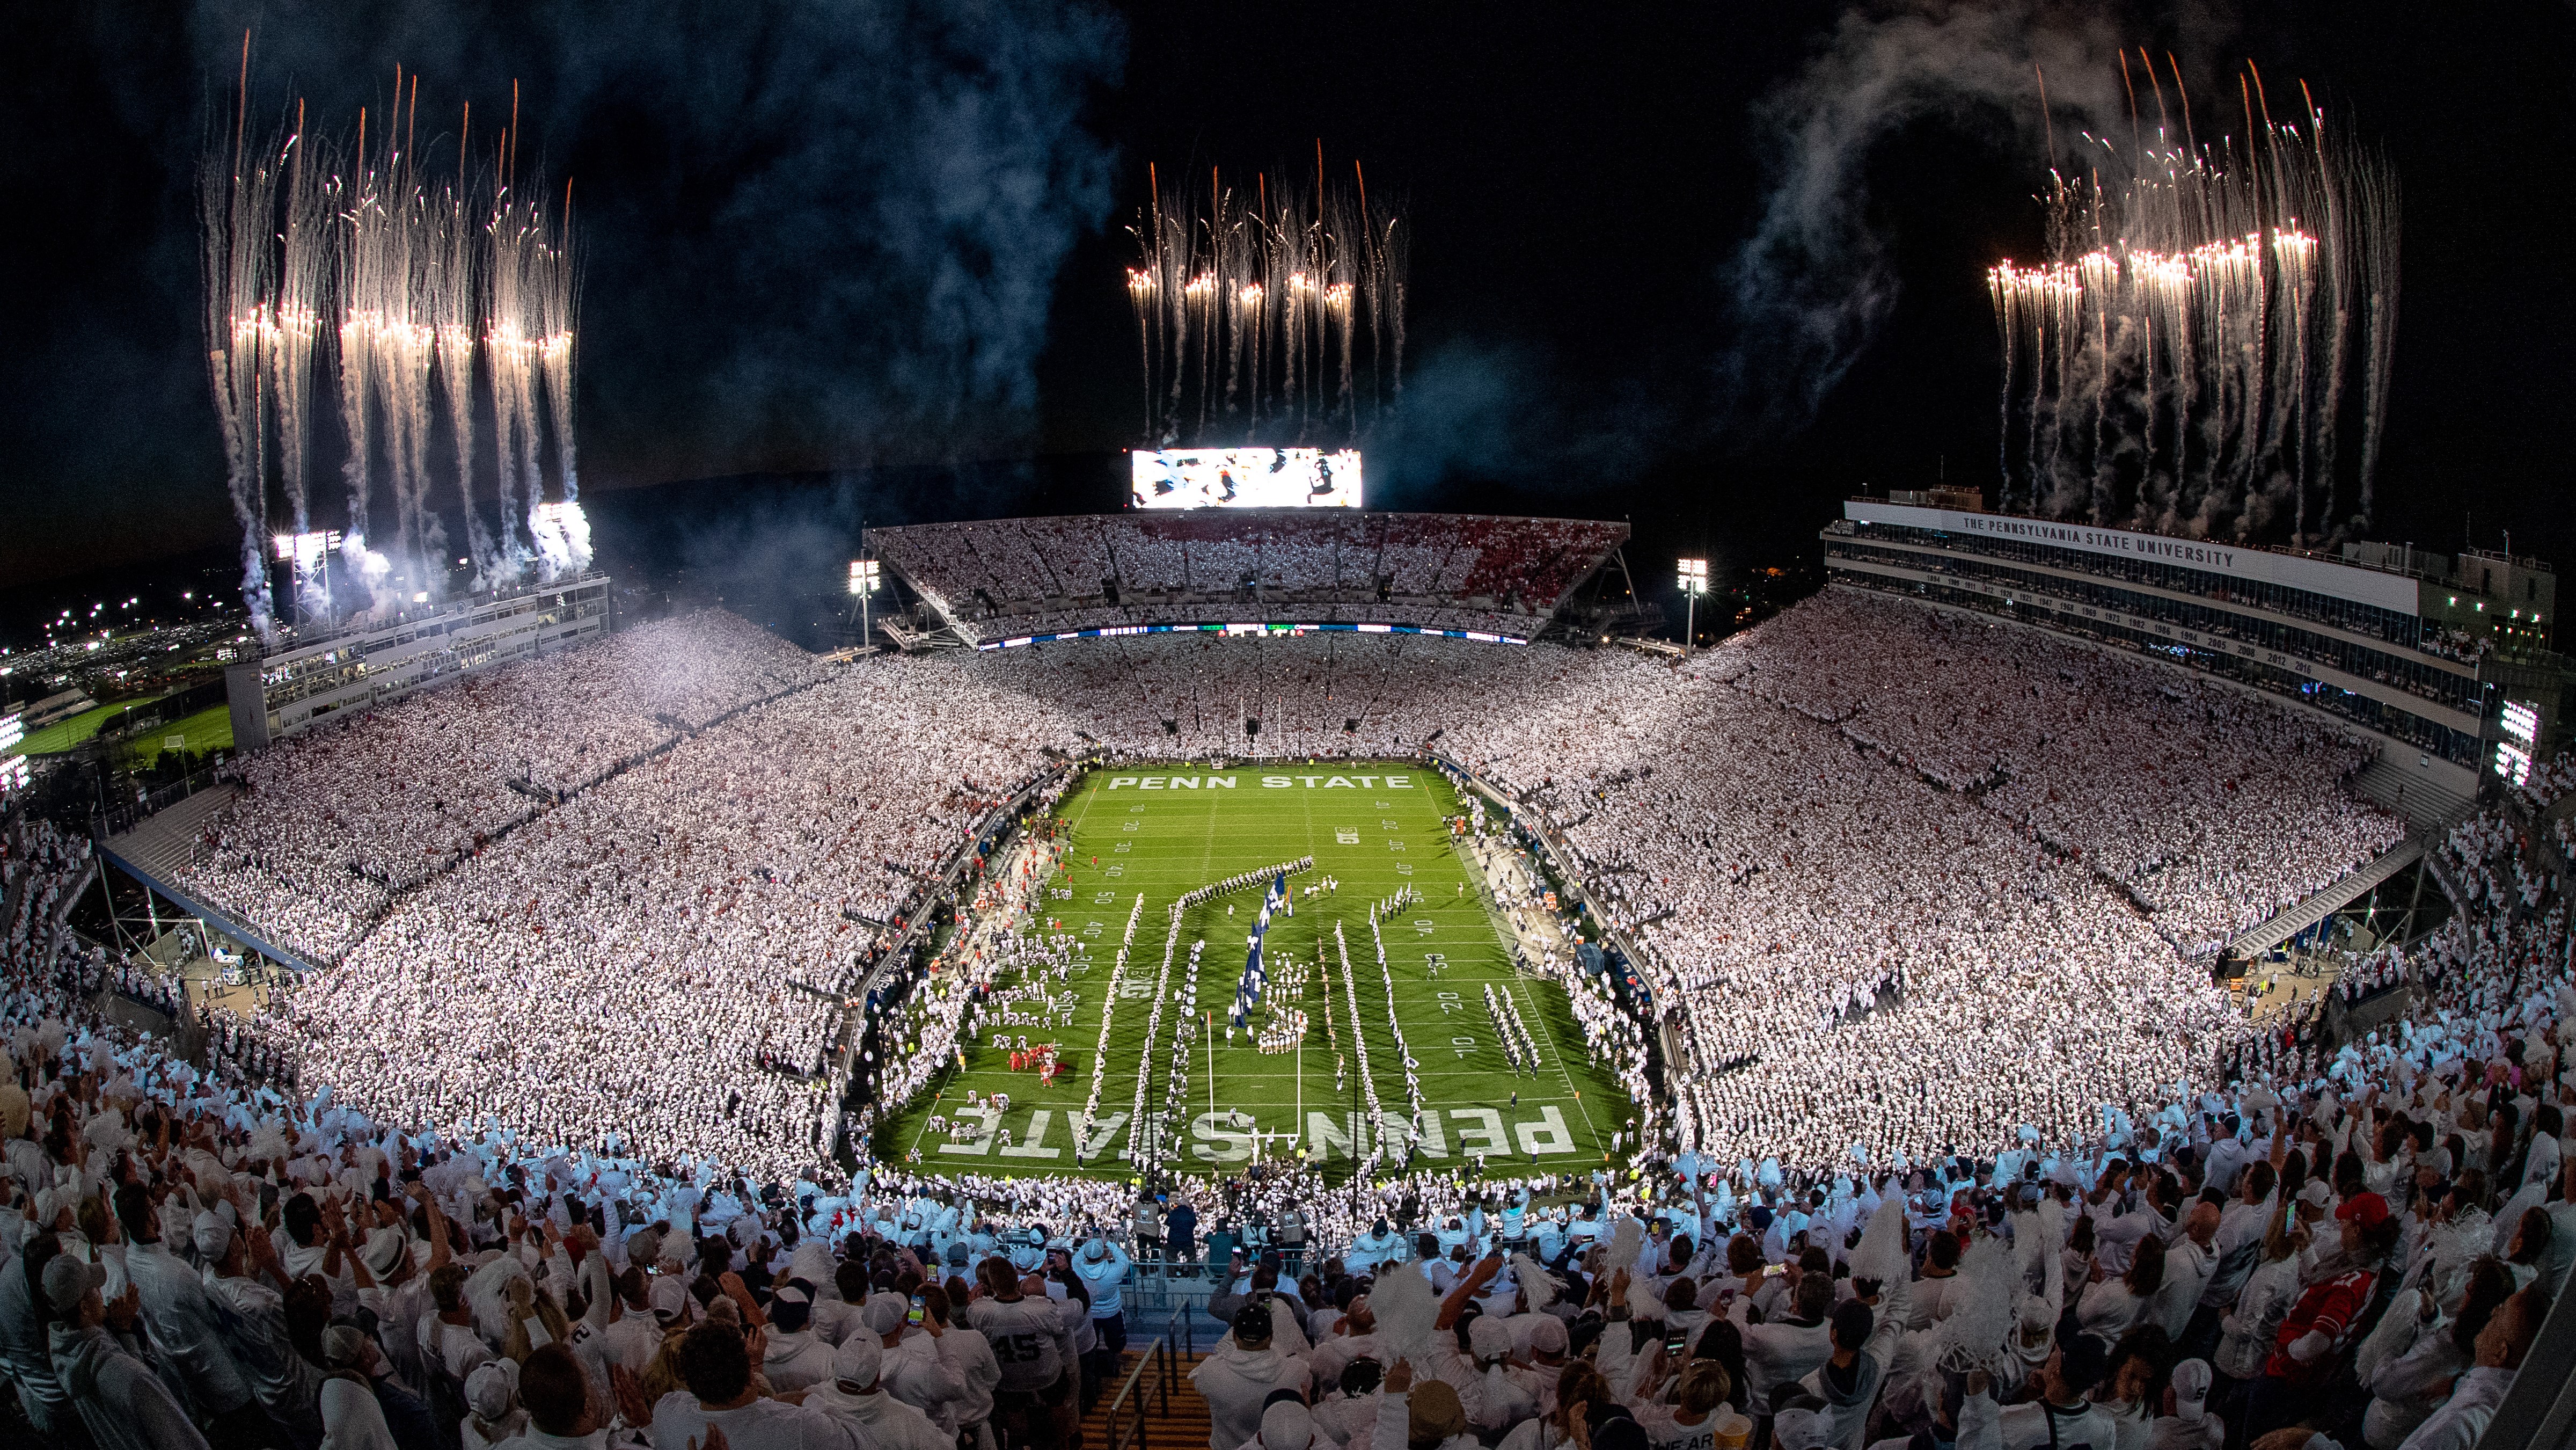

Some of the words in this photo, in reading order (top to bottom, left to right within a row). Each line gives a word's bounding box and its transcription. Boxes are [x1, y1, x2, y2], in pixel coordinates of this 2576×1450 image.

[1964, 518, 1984, 530] THE
[1989, 520, 2081, 543] PENNSYLVANIA
[2086, 533, 2129, 550] STATE
[2136, 539, 2233, 568] UNIVERSITY
[1965, 581, 1977, 591] 1911
[2019, 593, 2032, 602] 1921
[2039, 597, 2052, 607] 1947
[2060, 602, 2074, 612] 1968
[2082, 607, 2097, 617] 1969
[2105, 613, 2120, 623] 1973
[2128, 618, 2145, 629] 1982
[2154, 624, 2171, 636] 1986
[2180, 631, 2198, 643] 1994
[2208, 638, 2227, 650] 2005
[2237, 645, 2256, 657] 2008
[2267, 653, 2286, 666] 2012
[2295, 661, 2311, 674] 2016
[423, 653, 457, 670] BEAVER
[460, 642, 496, 659] STADIUM
[1108, 776, 1237, 790] PENN
[1262, 775, 1415, 789] STATE
[1123, 822, 1139, 832] 20
[1382, 821, 1399, 830] 20
[1114, 842, 1132, 852] 30
[1389, 841, 1406, 851] 30
[1106, 865, 1124, 876] 40
[1396, 865, 1413, 876] 40
[1095, 892, 1115, 903] 50
[1083, 921, 1104, 935] 40
[1414, 920, 1435, 934] 40
[1424, 953, 1448, 969] 30
[1437, 992, 1463, 1010] 20
[1452, 1037, 1478, 1052] 10
[938, 1107, 1253, 1162] STATE
[1306, 1105, 1577, 1160] PENN
[994, 1333, 1042, 1365] 45
